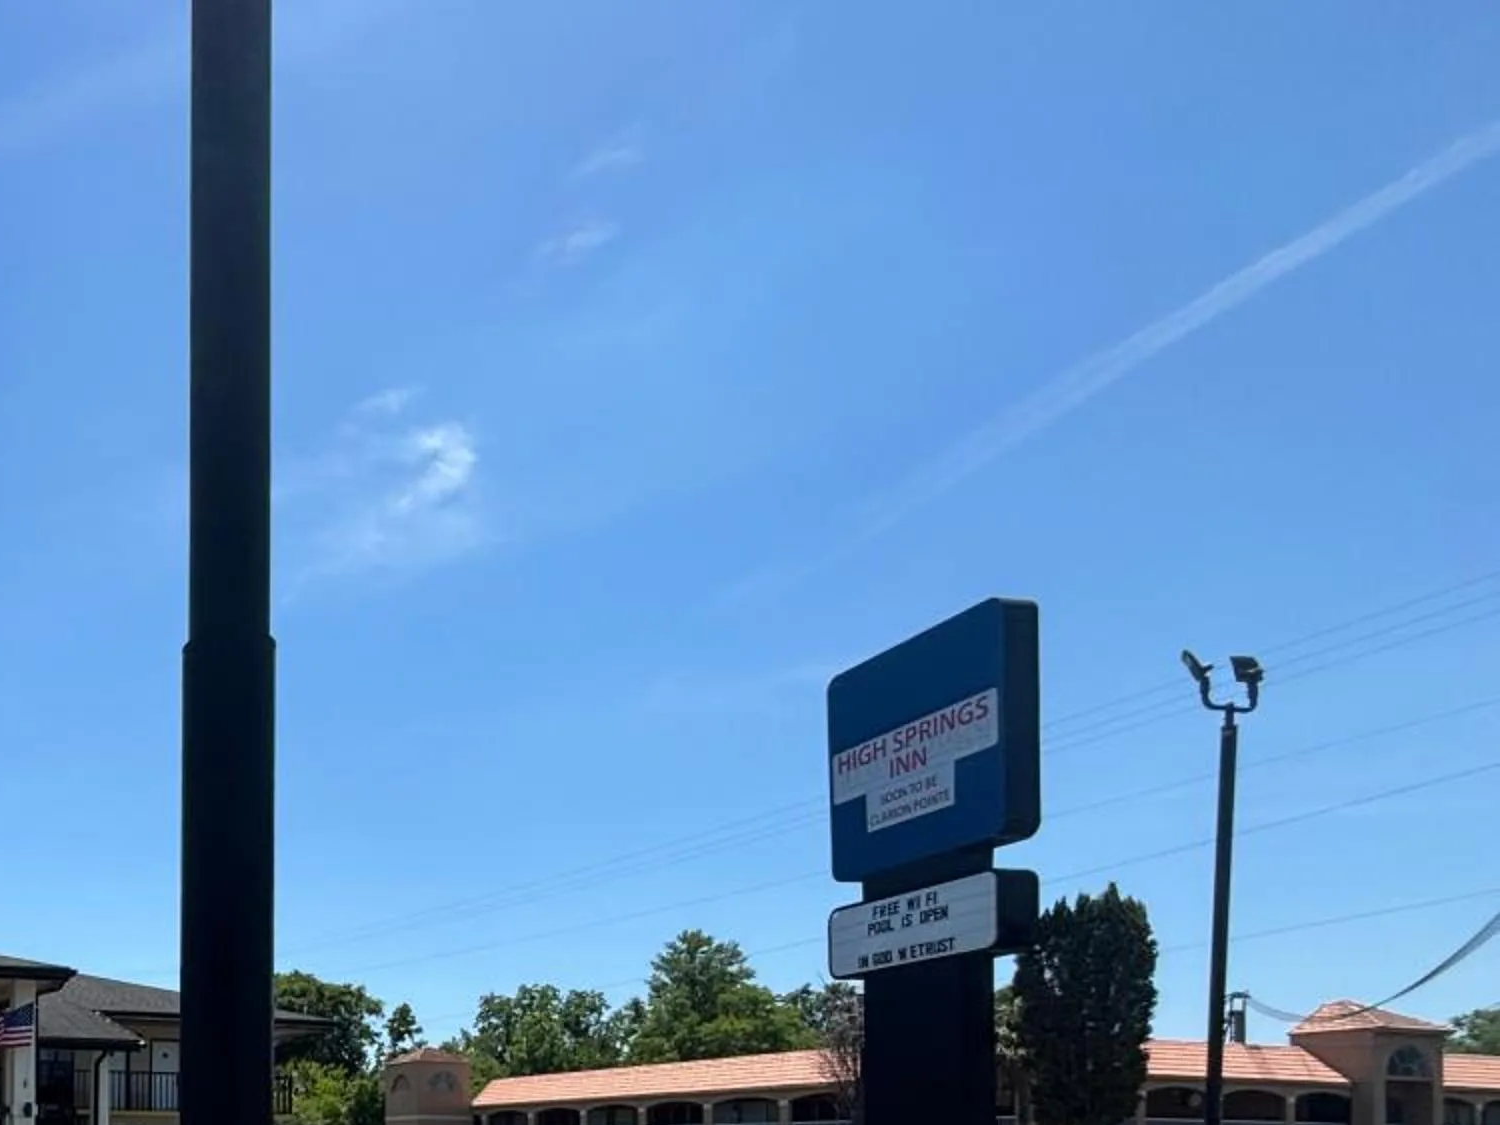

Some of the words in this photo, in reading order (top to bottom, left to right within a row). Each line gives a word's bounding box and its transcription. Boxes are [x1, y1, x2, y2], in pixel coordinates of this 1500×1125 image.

[837, 738, 887, 775] HIGH
[891, 695, 990, 753] SPRINGS
[888, 745, 928, 779] INN
[909, 780, 923, 794] TO
[870, 804, 912, 827] CLARION
[867, 918, 894, 937] POOL
[901, 913, 913, 929] IS
[919, 903, 949, 925] OPEN
[872, 901, 900, 920] FREE
[857, 954, 870, 969] IN
[872, 949, 893, 966] GOD
